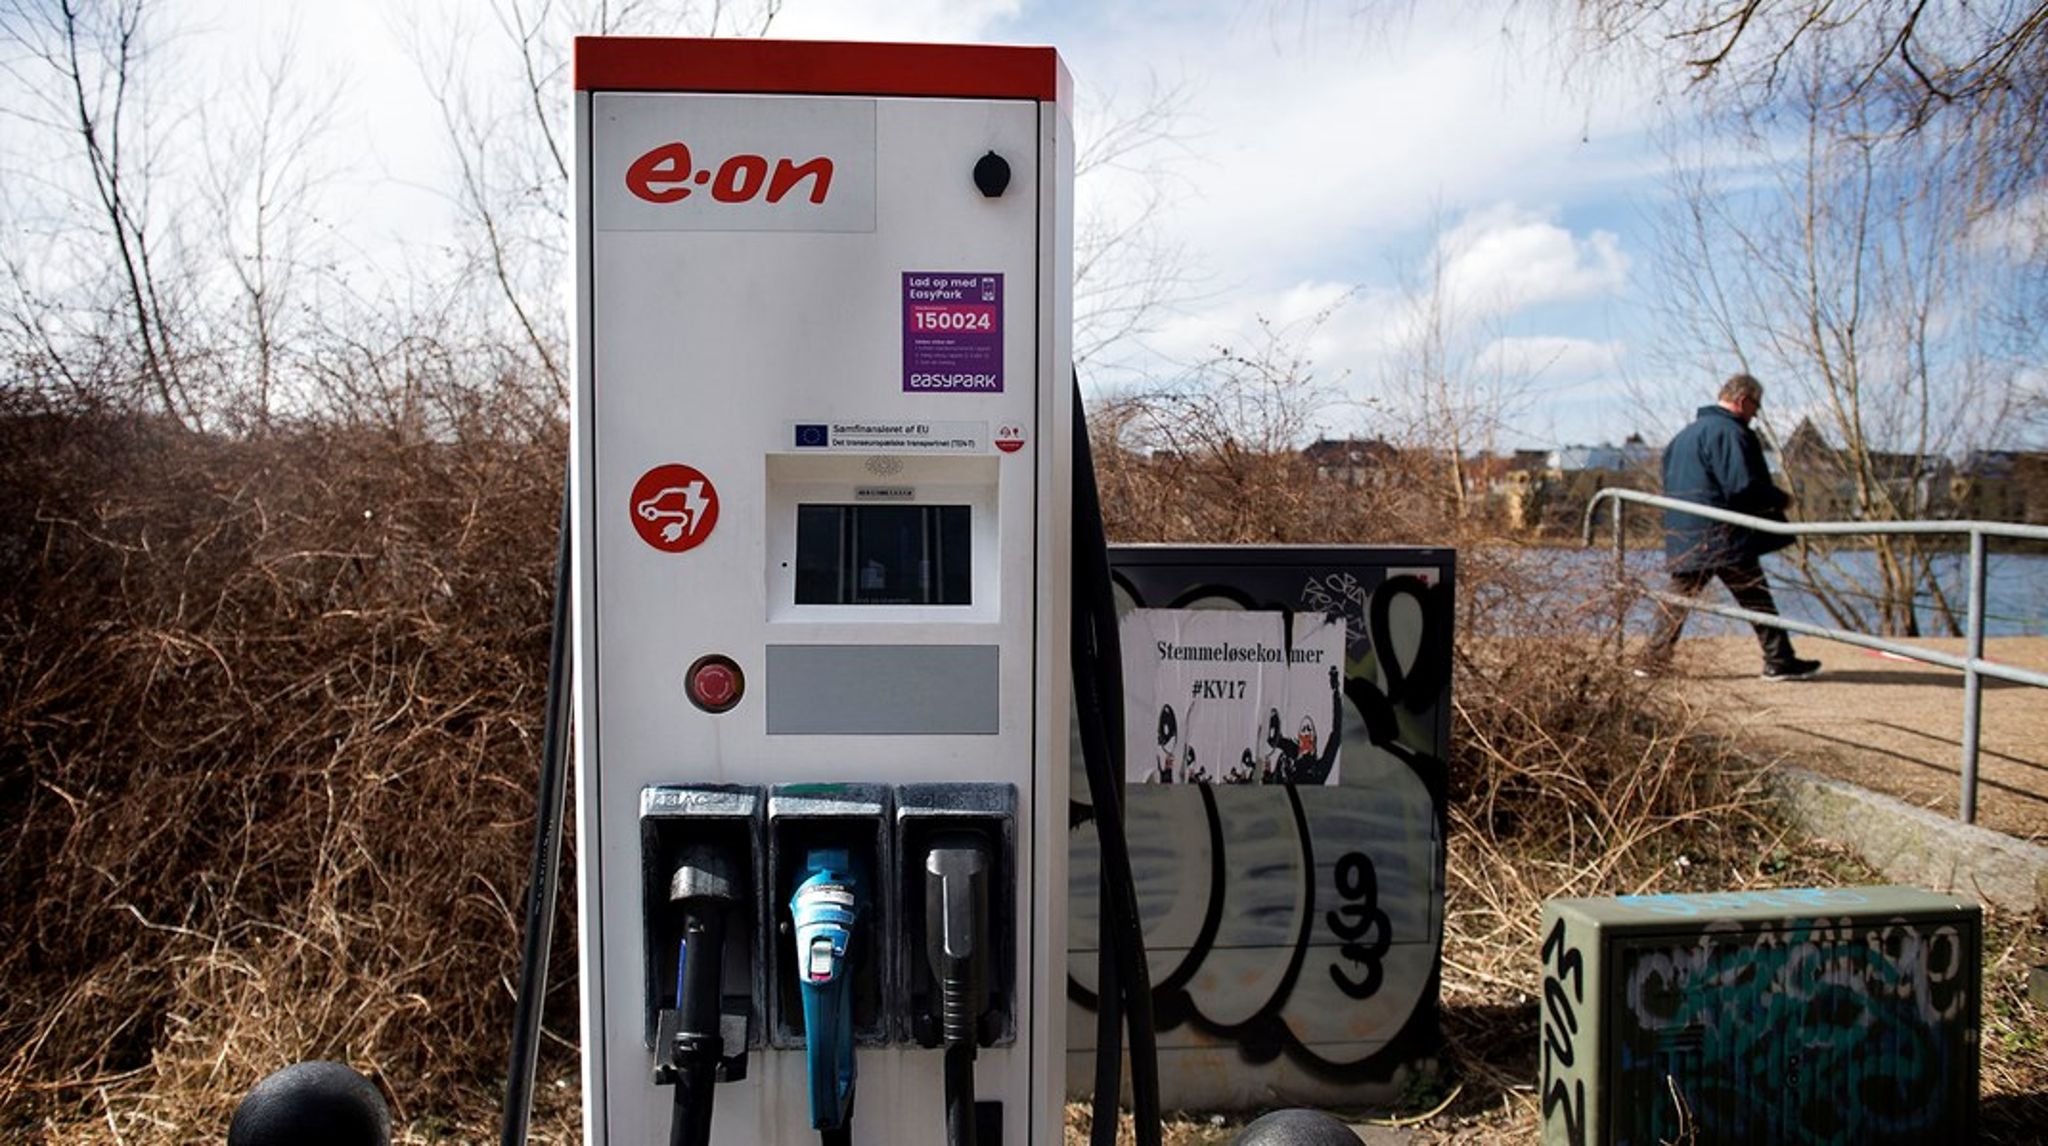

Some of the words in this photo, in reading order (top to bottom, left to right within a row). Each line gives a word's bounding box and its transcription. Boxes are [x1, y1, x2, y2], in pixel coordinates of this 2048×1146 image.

[909, 277, 930, 287] Lad
[933, 279, 948, 289] op
[951, 277, 977, 288] med
[909, 289, 963, 301] EasyPark
[915, 313, 990, 330] 150024
[905, 424, 915, 434] af
[917, 424, 930, 434] EU
[1192, 680, 1247, 700] #KV17
